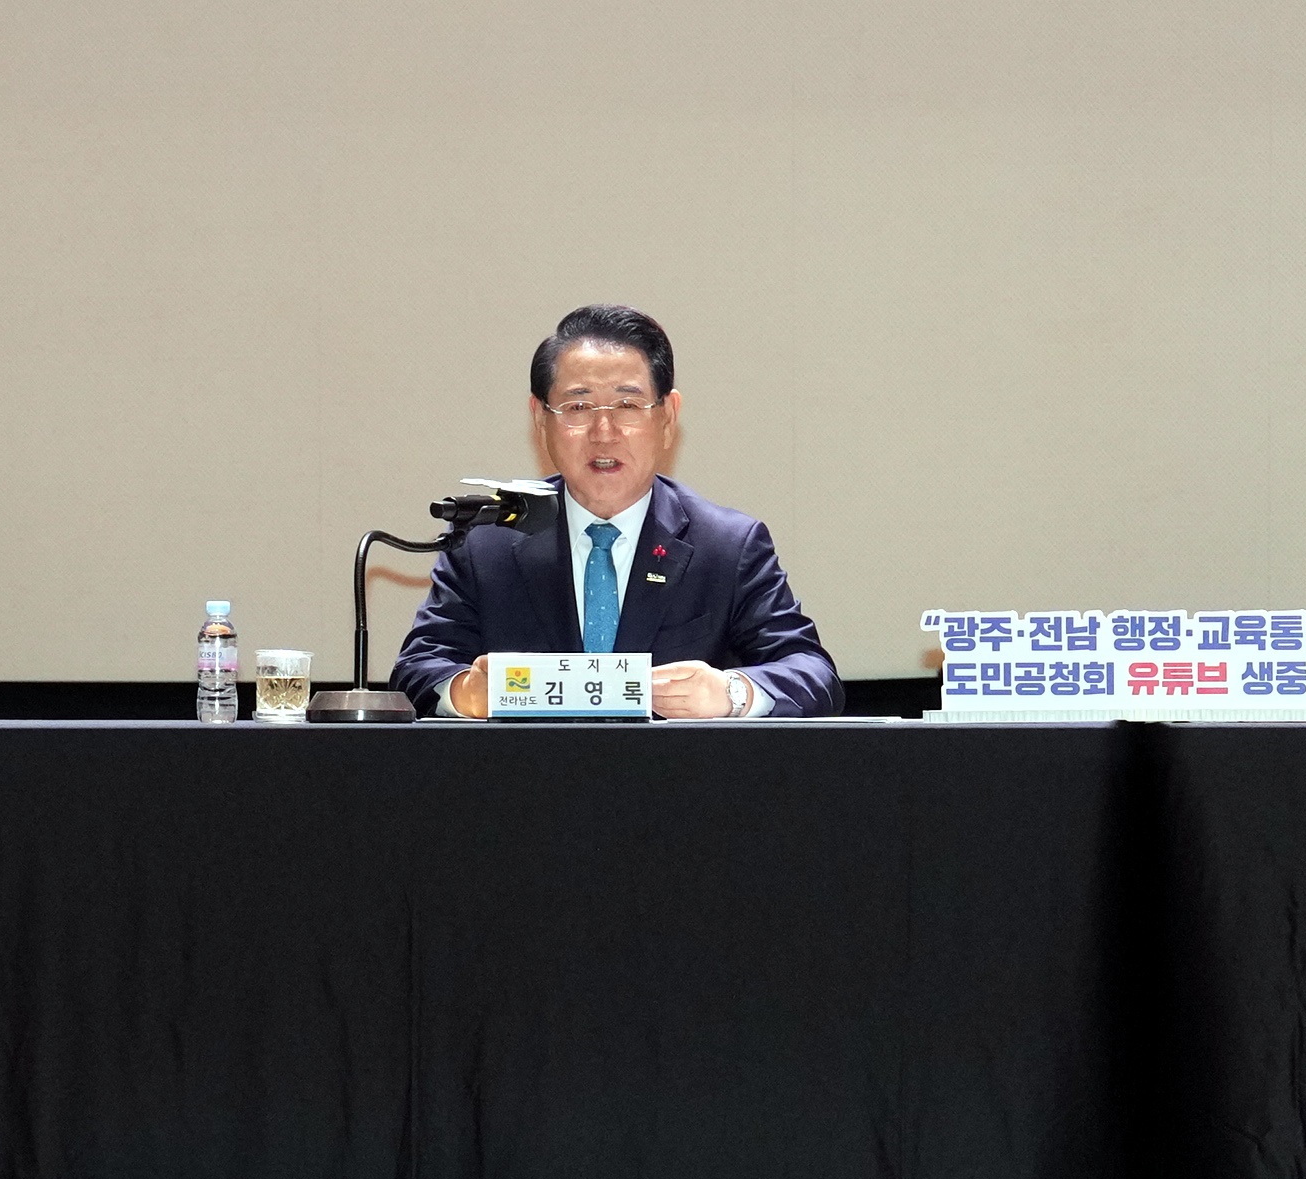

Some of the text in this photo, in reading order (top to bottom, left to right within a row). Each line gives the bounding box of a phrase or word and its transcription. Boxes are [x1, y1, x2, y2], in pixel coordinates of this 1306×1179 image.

[945, 661, 1115, 696] 도민공청회
[1127, 661, 1229, 696] 유튜브
[499, 695, 538, 706] 전라남도
